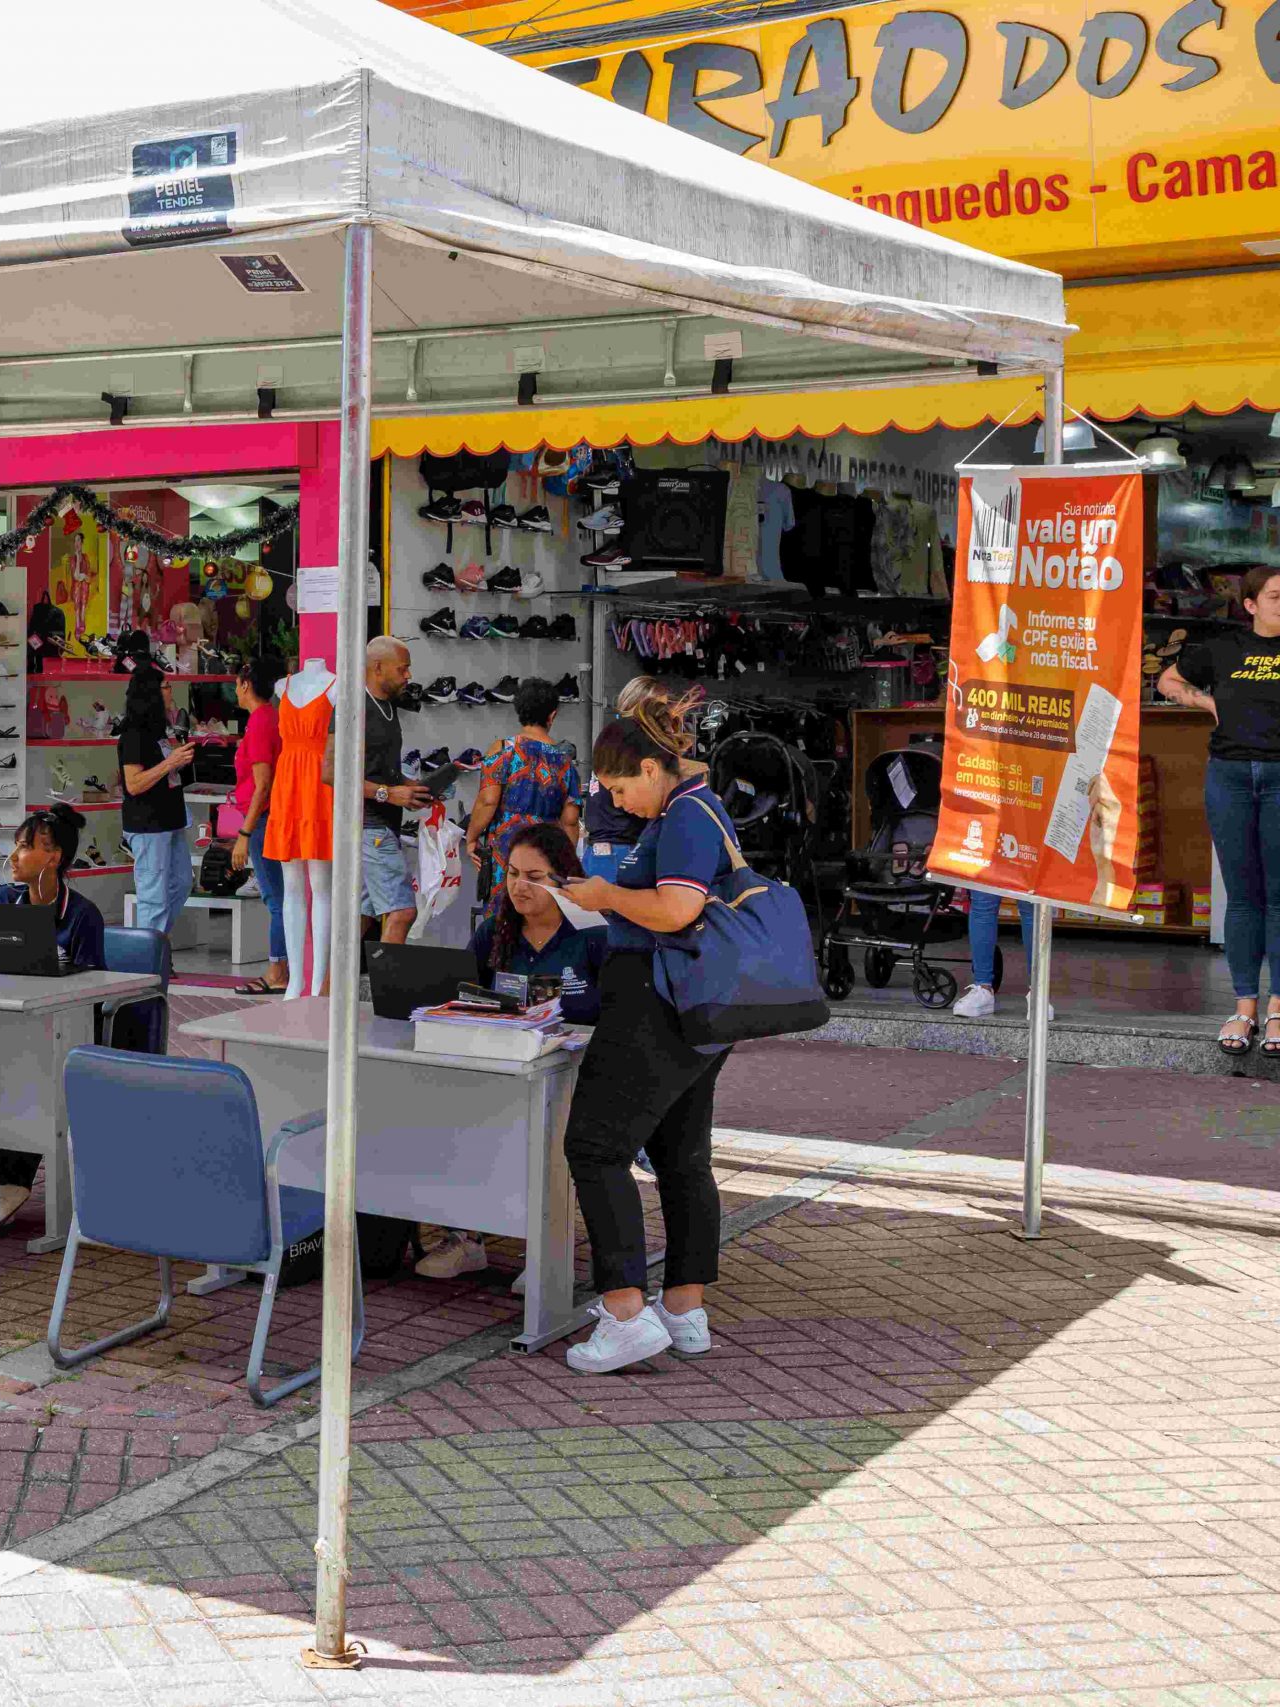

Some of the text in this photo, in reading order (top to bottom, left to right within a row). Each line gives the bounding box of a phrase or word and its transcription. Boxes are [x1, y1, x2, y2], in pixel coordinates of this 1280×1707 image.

[157, 195, 203, 209] TENDAS
[851, 169, 1070, 228] inquedos
[1064, 502, 1116, 516] Sua notinha
[1026, 512, 1117, 545] vale um
[1018, 544, 1124, 591] Notão
[1028, 610, 1096, 630] Informe seu
[1023, 630, 1098, 653] CPF e exija a
[1031, 652, 1058, 668] nota
[967, 687, 1072, 718] 400 MIL REAIS
[1026, 717, 1035, 725] 44
[1036, 718, 1069, 730] premiados
[957, 753, 1022, 776] Cadastre-se
[956, 771, 974, 783] em
[976, 774, 1006, 788] nosso
